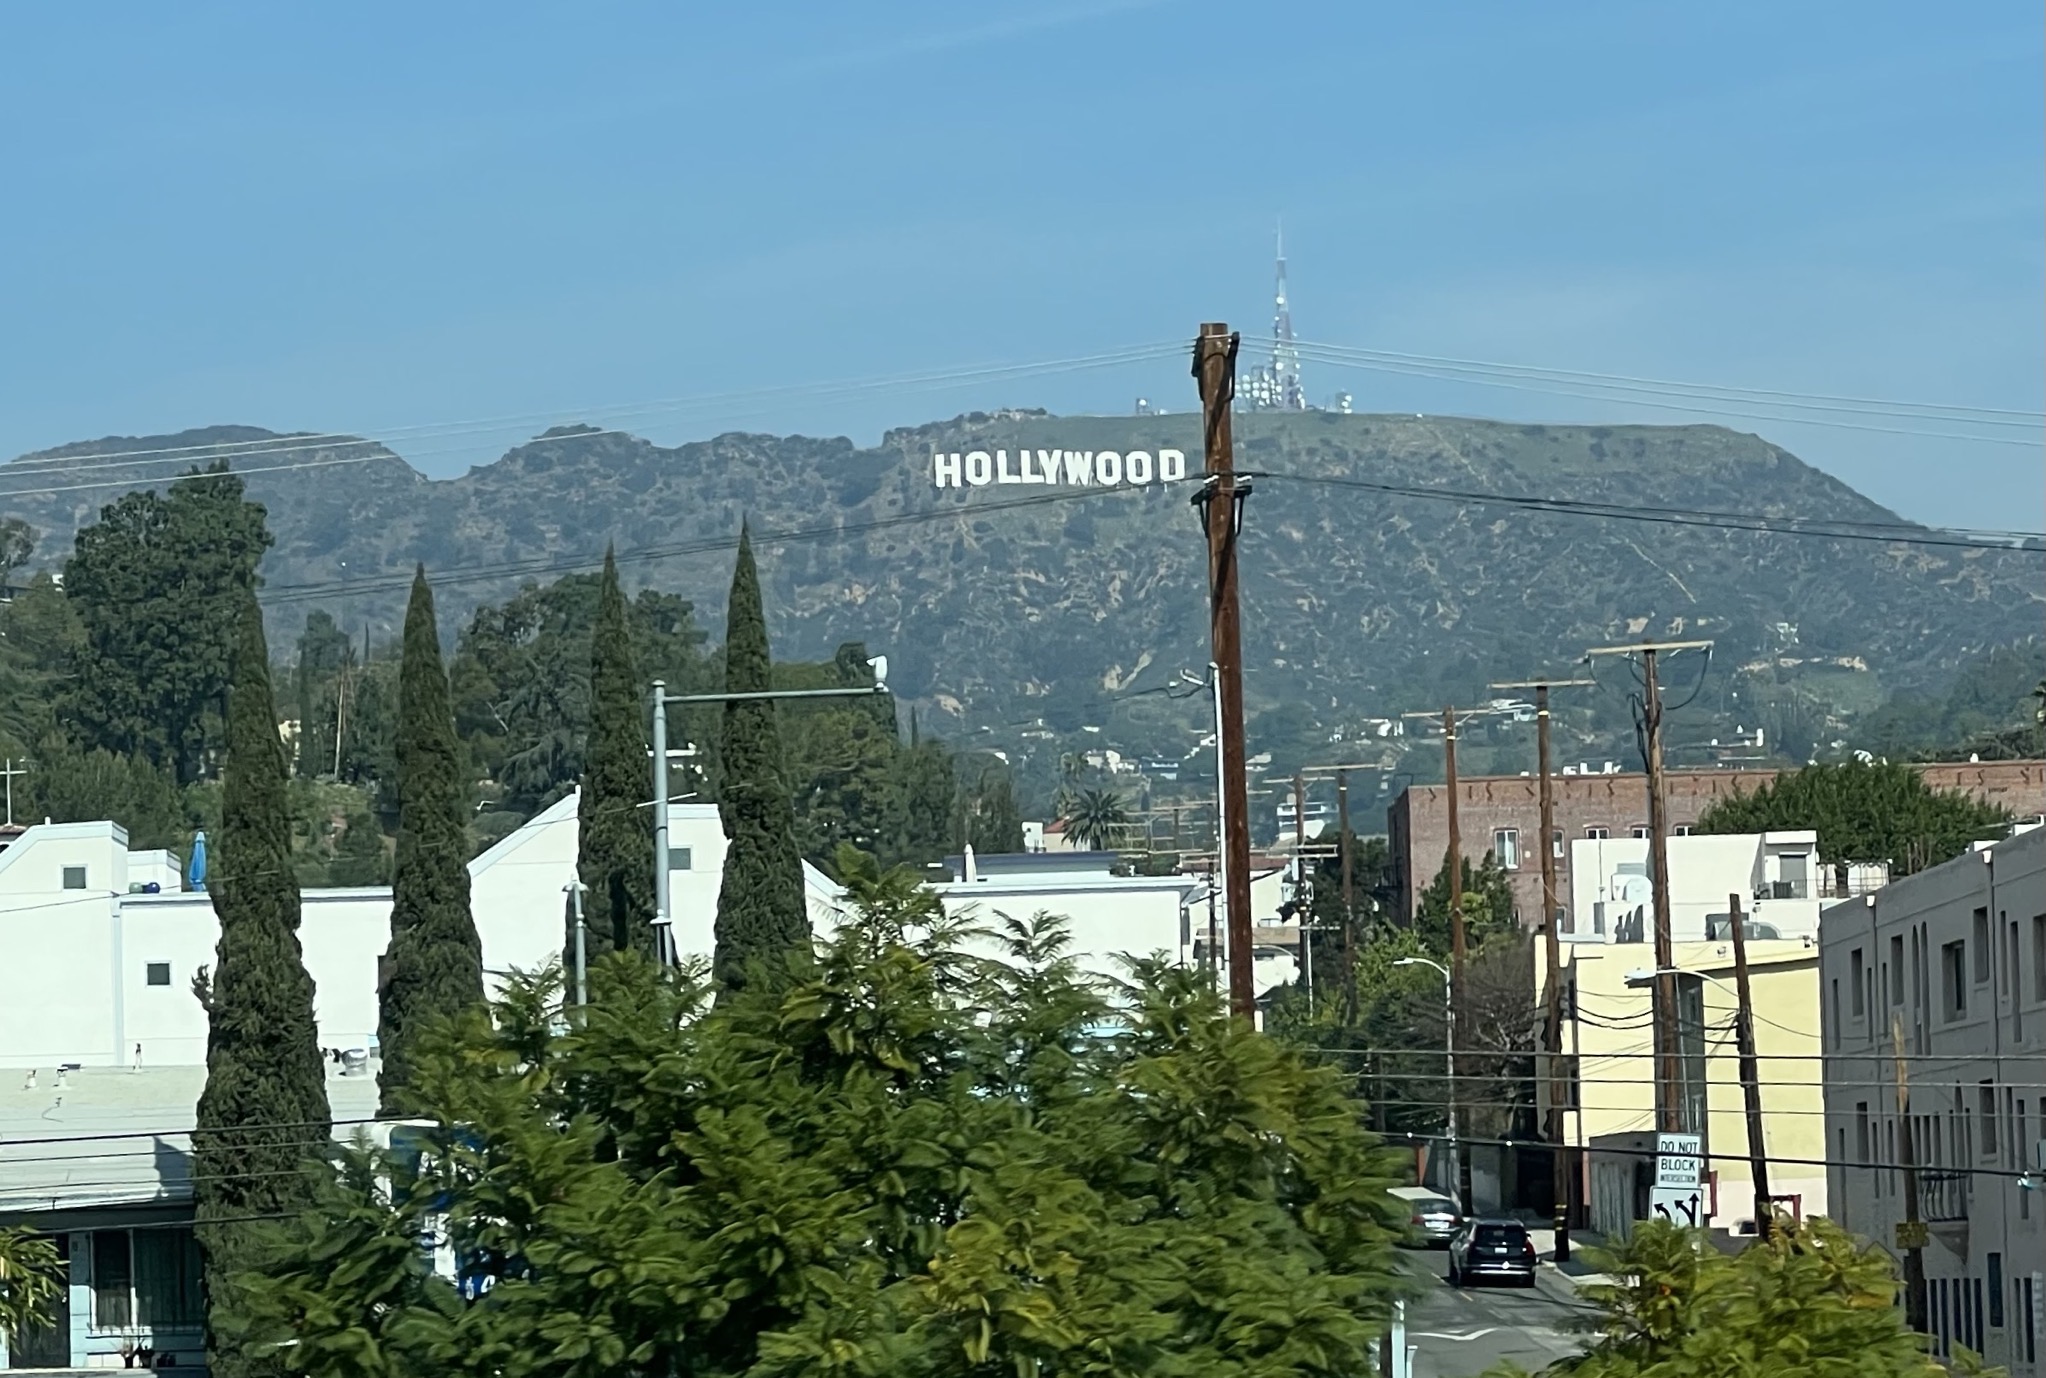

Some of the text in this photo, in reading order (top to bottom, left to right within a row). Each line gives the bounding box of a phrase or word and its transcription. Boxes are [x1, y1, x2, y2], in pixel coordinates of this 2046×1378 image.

[934, 450, 1186, 488] HOLLYWOOD
[1660, 1141, 1698, 1155] DO NOT
[1660, 1158, 1696, 1171] BLOCK
